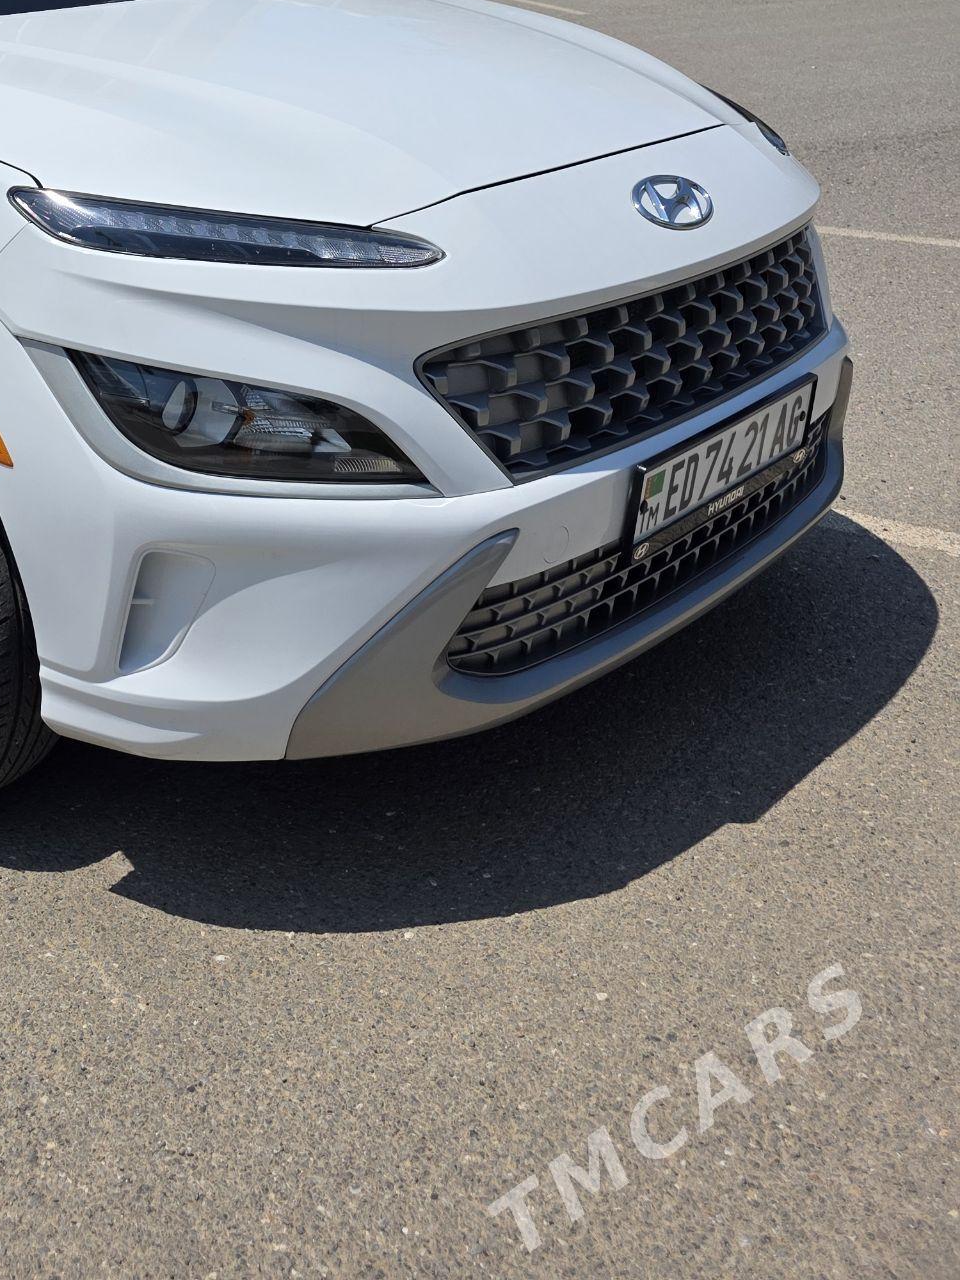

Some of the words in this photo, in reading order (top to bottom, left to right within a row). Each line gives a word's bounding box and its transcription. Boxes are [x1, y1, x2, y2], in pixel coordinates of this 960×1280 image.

[663, 453, 700, 520] ED
[698, 431, 737, 501] 74
[737, 413, 770, 478] 21
[769, 395, 803, 459] AG
[707, 485, 745, 516] HYUNDAI
